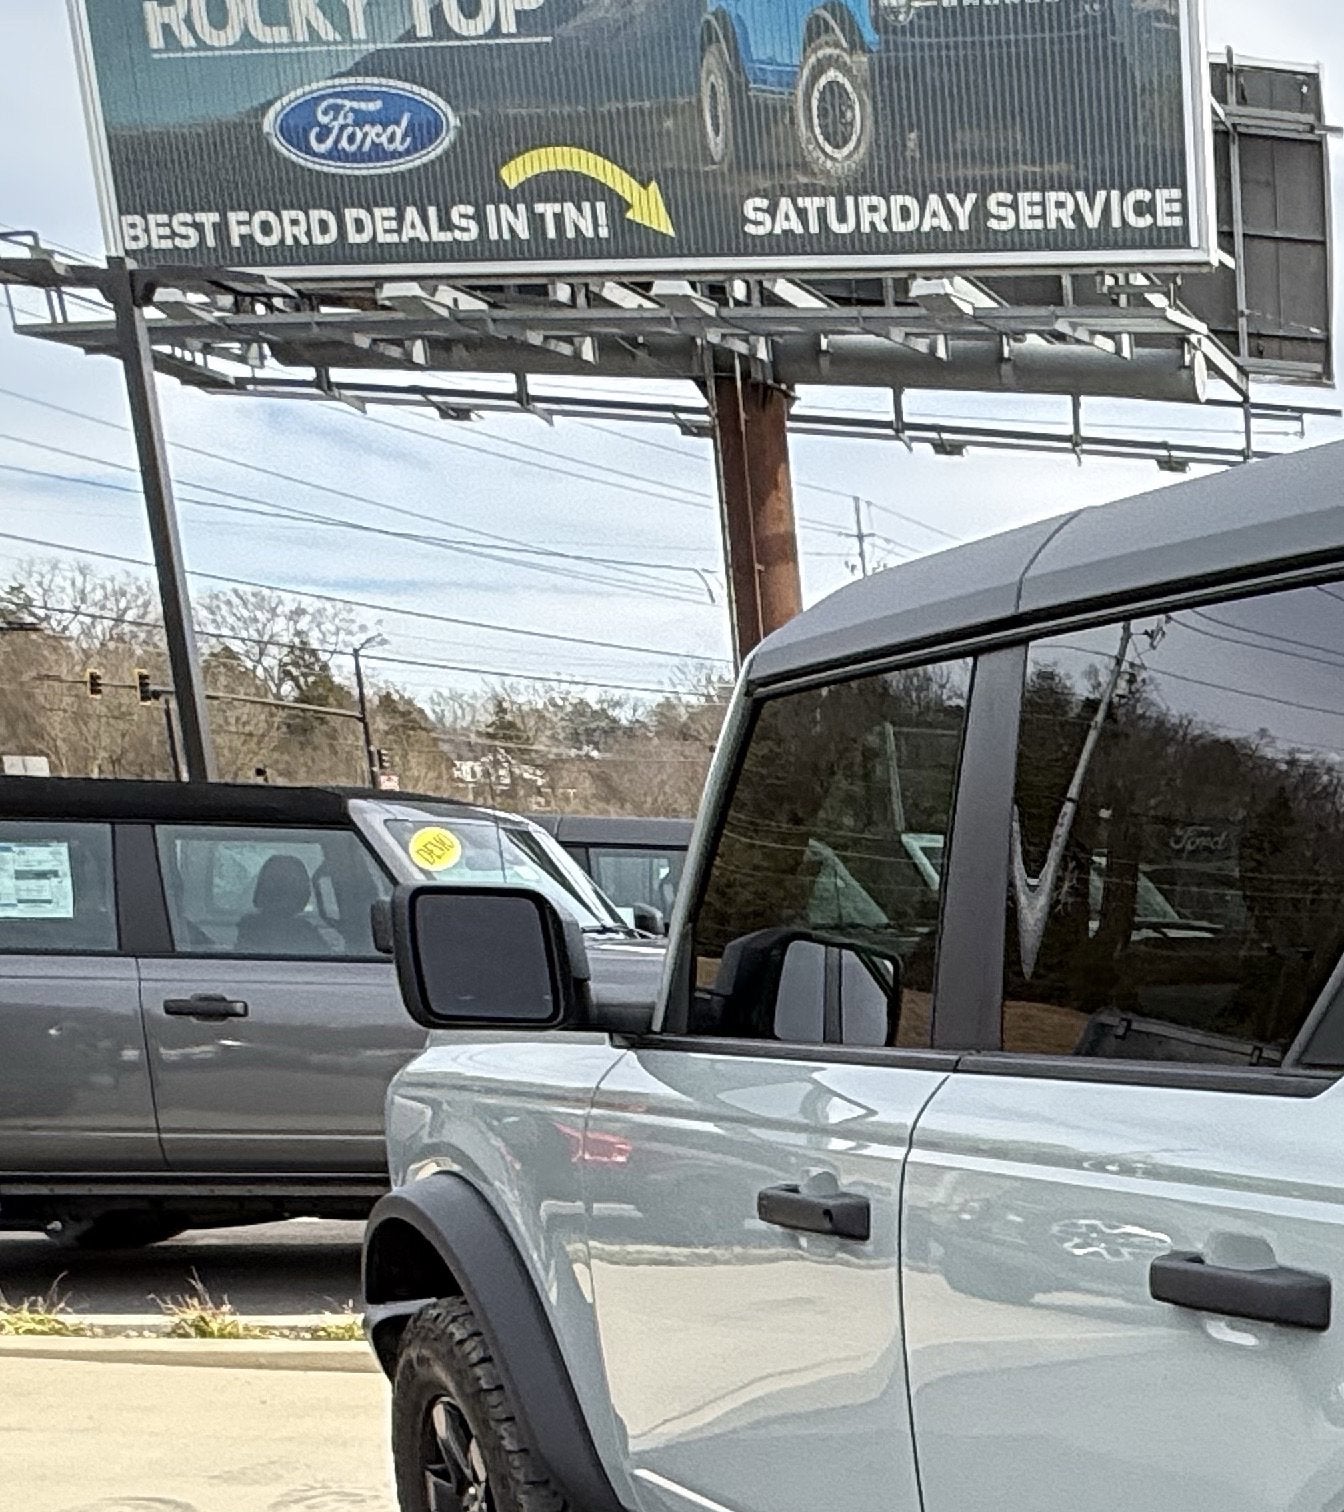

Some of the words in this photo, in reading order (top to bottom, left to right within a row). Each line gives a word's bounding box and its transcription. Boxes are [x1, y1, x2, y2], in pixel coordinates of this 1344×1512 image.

[143, 0, 369, 49] ROCKY
[310, 98, 412, 153] Ford
[121, 211, 221, 250] BEST
[226, 208, 338, 247] FORD
[343, 204, 480, 245] DEALS
[485, 202, 530, 241] IN
[533, 201, 609, 239] TN!
[742, 193, 978, 236] SATURDAY
[985, 188, 1184, 232] SERVICE
[416, 833, 455, 865] DEMO
